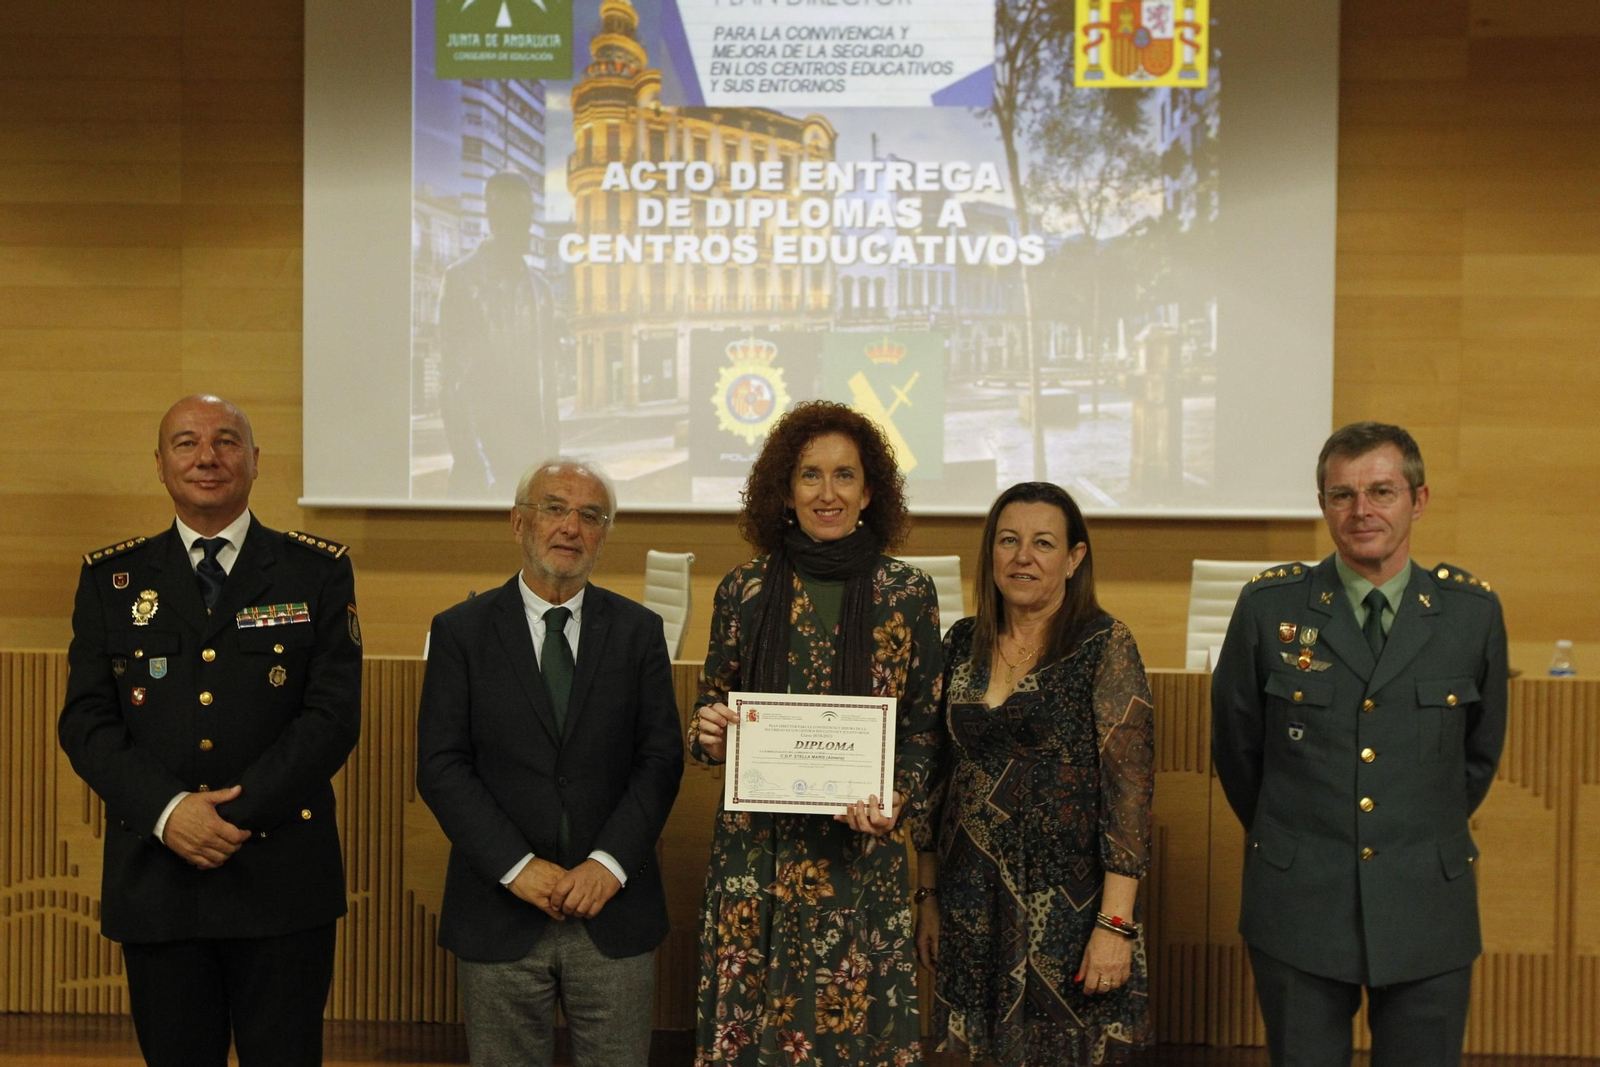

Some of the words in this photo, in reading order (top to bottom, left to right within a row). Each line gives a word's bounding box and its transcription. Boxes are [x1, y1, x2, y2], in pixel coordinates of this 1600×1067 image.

[446, 33, 480, 48] JUNTA
[485, 33, 498, 48] DE
[714, 26, 756, 41] PARA
[760, 26, 781, 41] LA
[787, 26, 894, 41] CONVIVENCIA
[900, 26, 910, 40] Y
[712, 44, 777, 59] MEJORA
[781, 44, 804, 59] DE
[806, 44, 827, 59] LA
[831, 44, 924, 59] SEGURIDAD
[710, 61, 736, 76] EN
[739, 61, 766, 76] LOS
[770, 61, 847, 76] CENTROS
[851, 61, 954, 76] EDUCATIVOS
[710, 79, 721, 93] Y
[722, 79, 753, 93] SUS
[757, 79, 845, 94] ENTORNOS
[601, 161, 714, 192] ACTO
[730, 161, 784, 191] DE
[799, 161, 1004, 192] ENTREGA
[638, 198, 691, 228] DE
[706, 198, 923, 229] DIPLOMAS
[937, 199, 968, 228] A
[558, 233, 759, 264] CENTROS
[773, 234, 1047, 265] EDUCATIVOS
[793, 740, 855, 751] DIPLOMA
